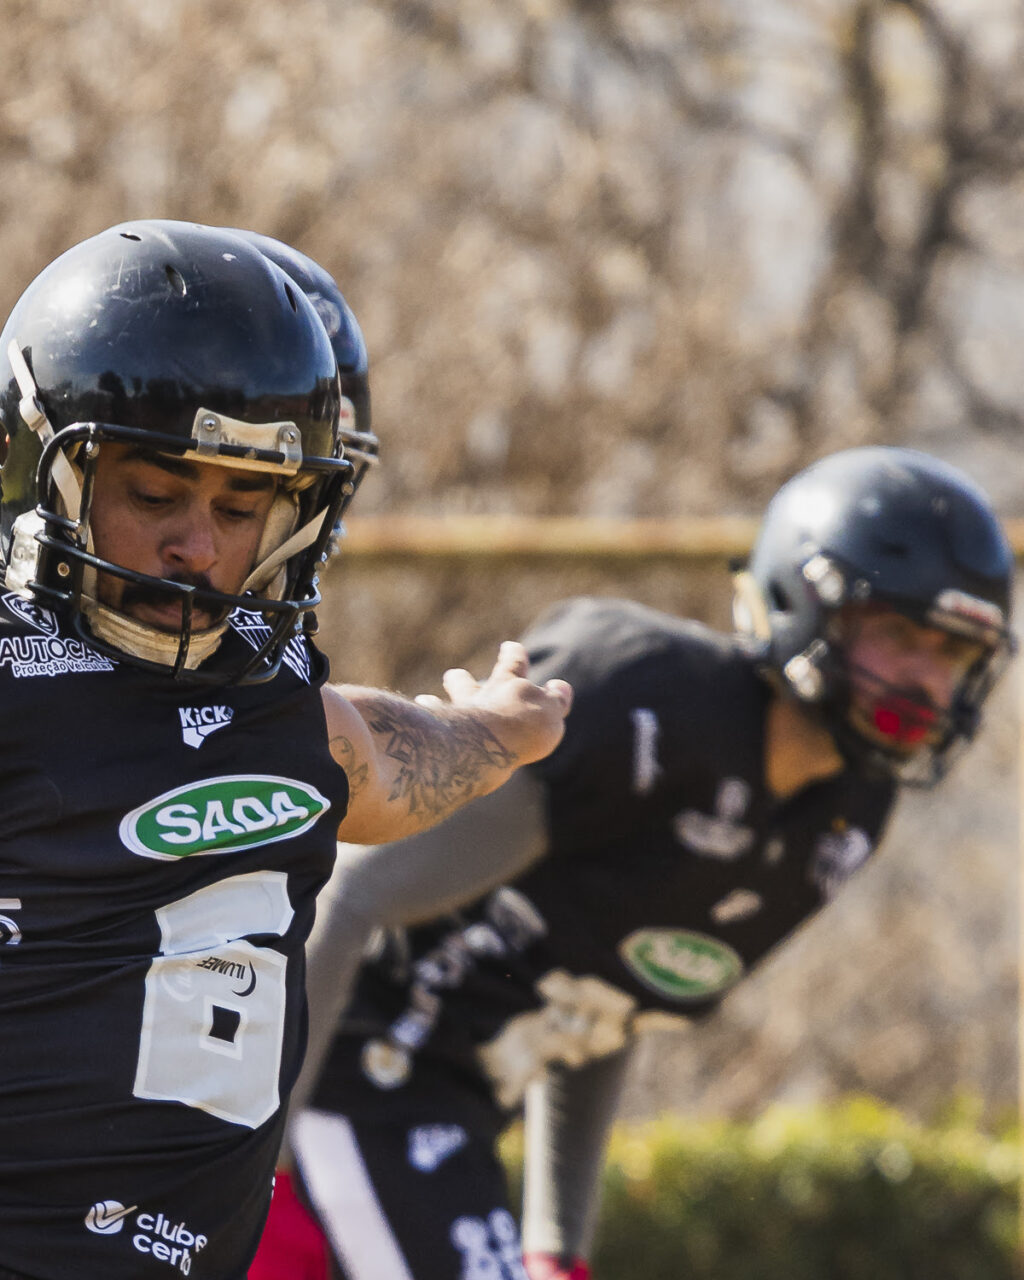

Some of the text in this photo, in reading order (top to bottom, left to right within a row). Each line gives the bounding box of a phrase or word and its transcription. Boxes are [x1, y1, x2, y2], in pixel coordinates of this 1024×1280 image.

[233, 615, 265, 627] CAM
[12, 660, 67, 677] Proteção
[155, 791, 309, 844] SADA
[132, 870, 295, 1130] 6
